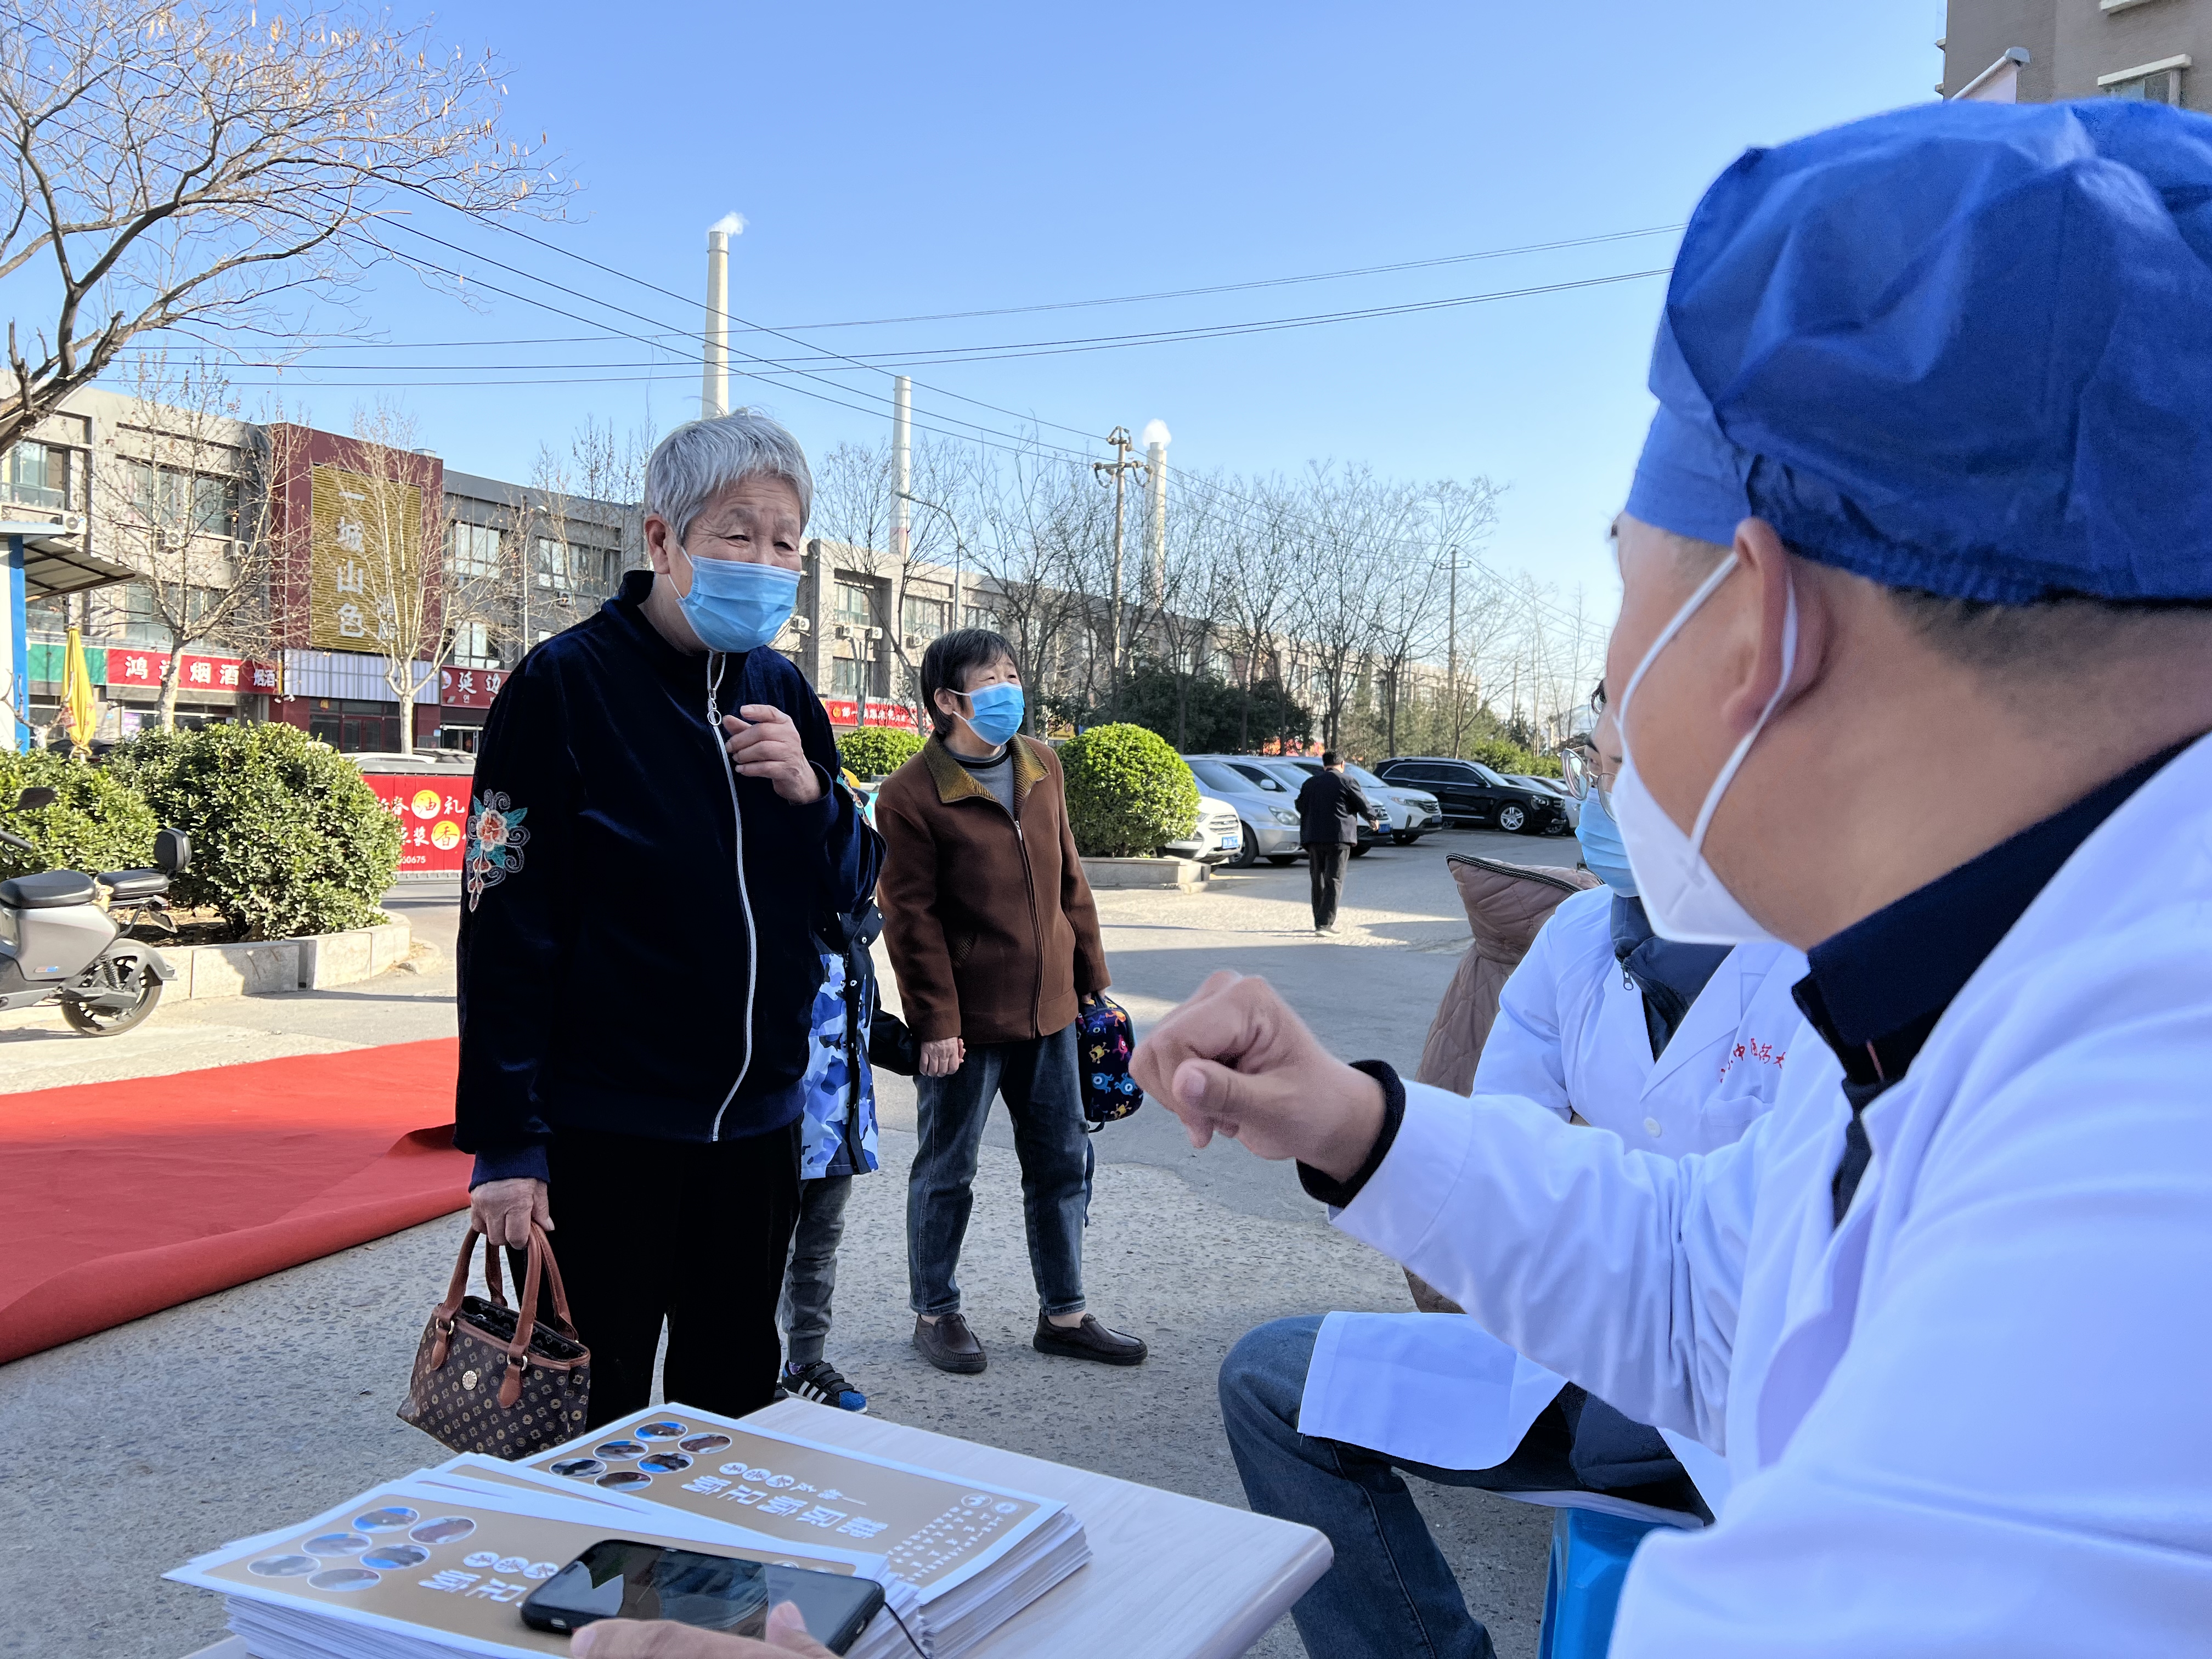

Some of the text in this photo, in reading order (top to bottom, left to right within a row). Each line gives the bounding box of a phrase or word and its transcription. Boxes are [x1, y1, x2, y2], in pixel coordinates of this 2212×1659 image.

[681, 1475, 889, 1539] 糖尿病足病
[418, 1569, 528, 1609] 足病
